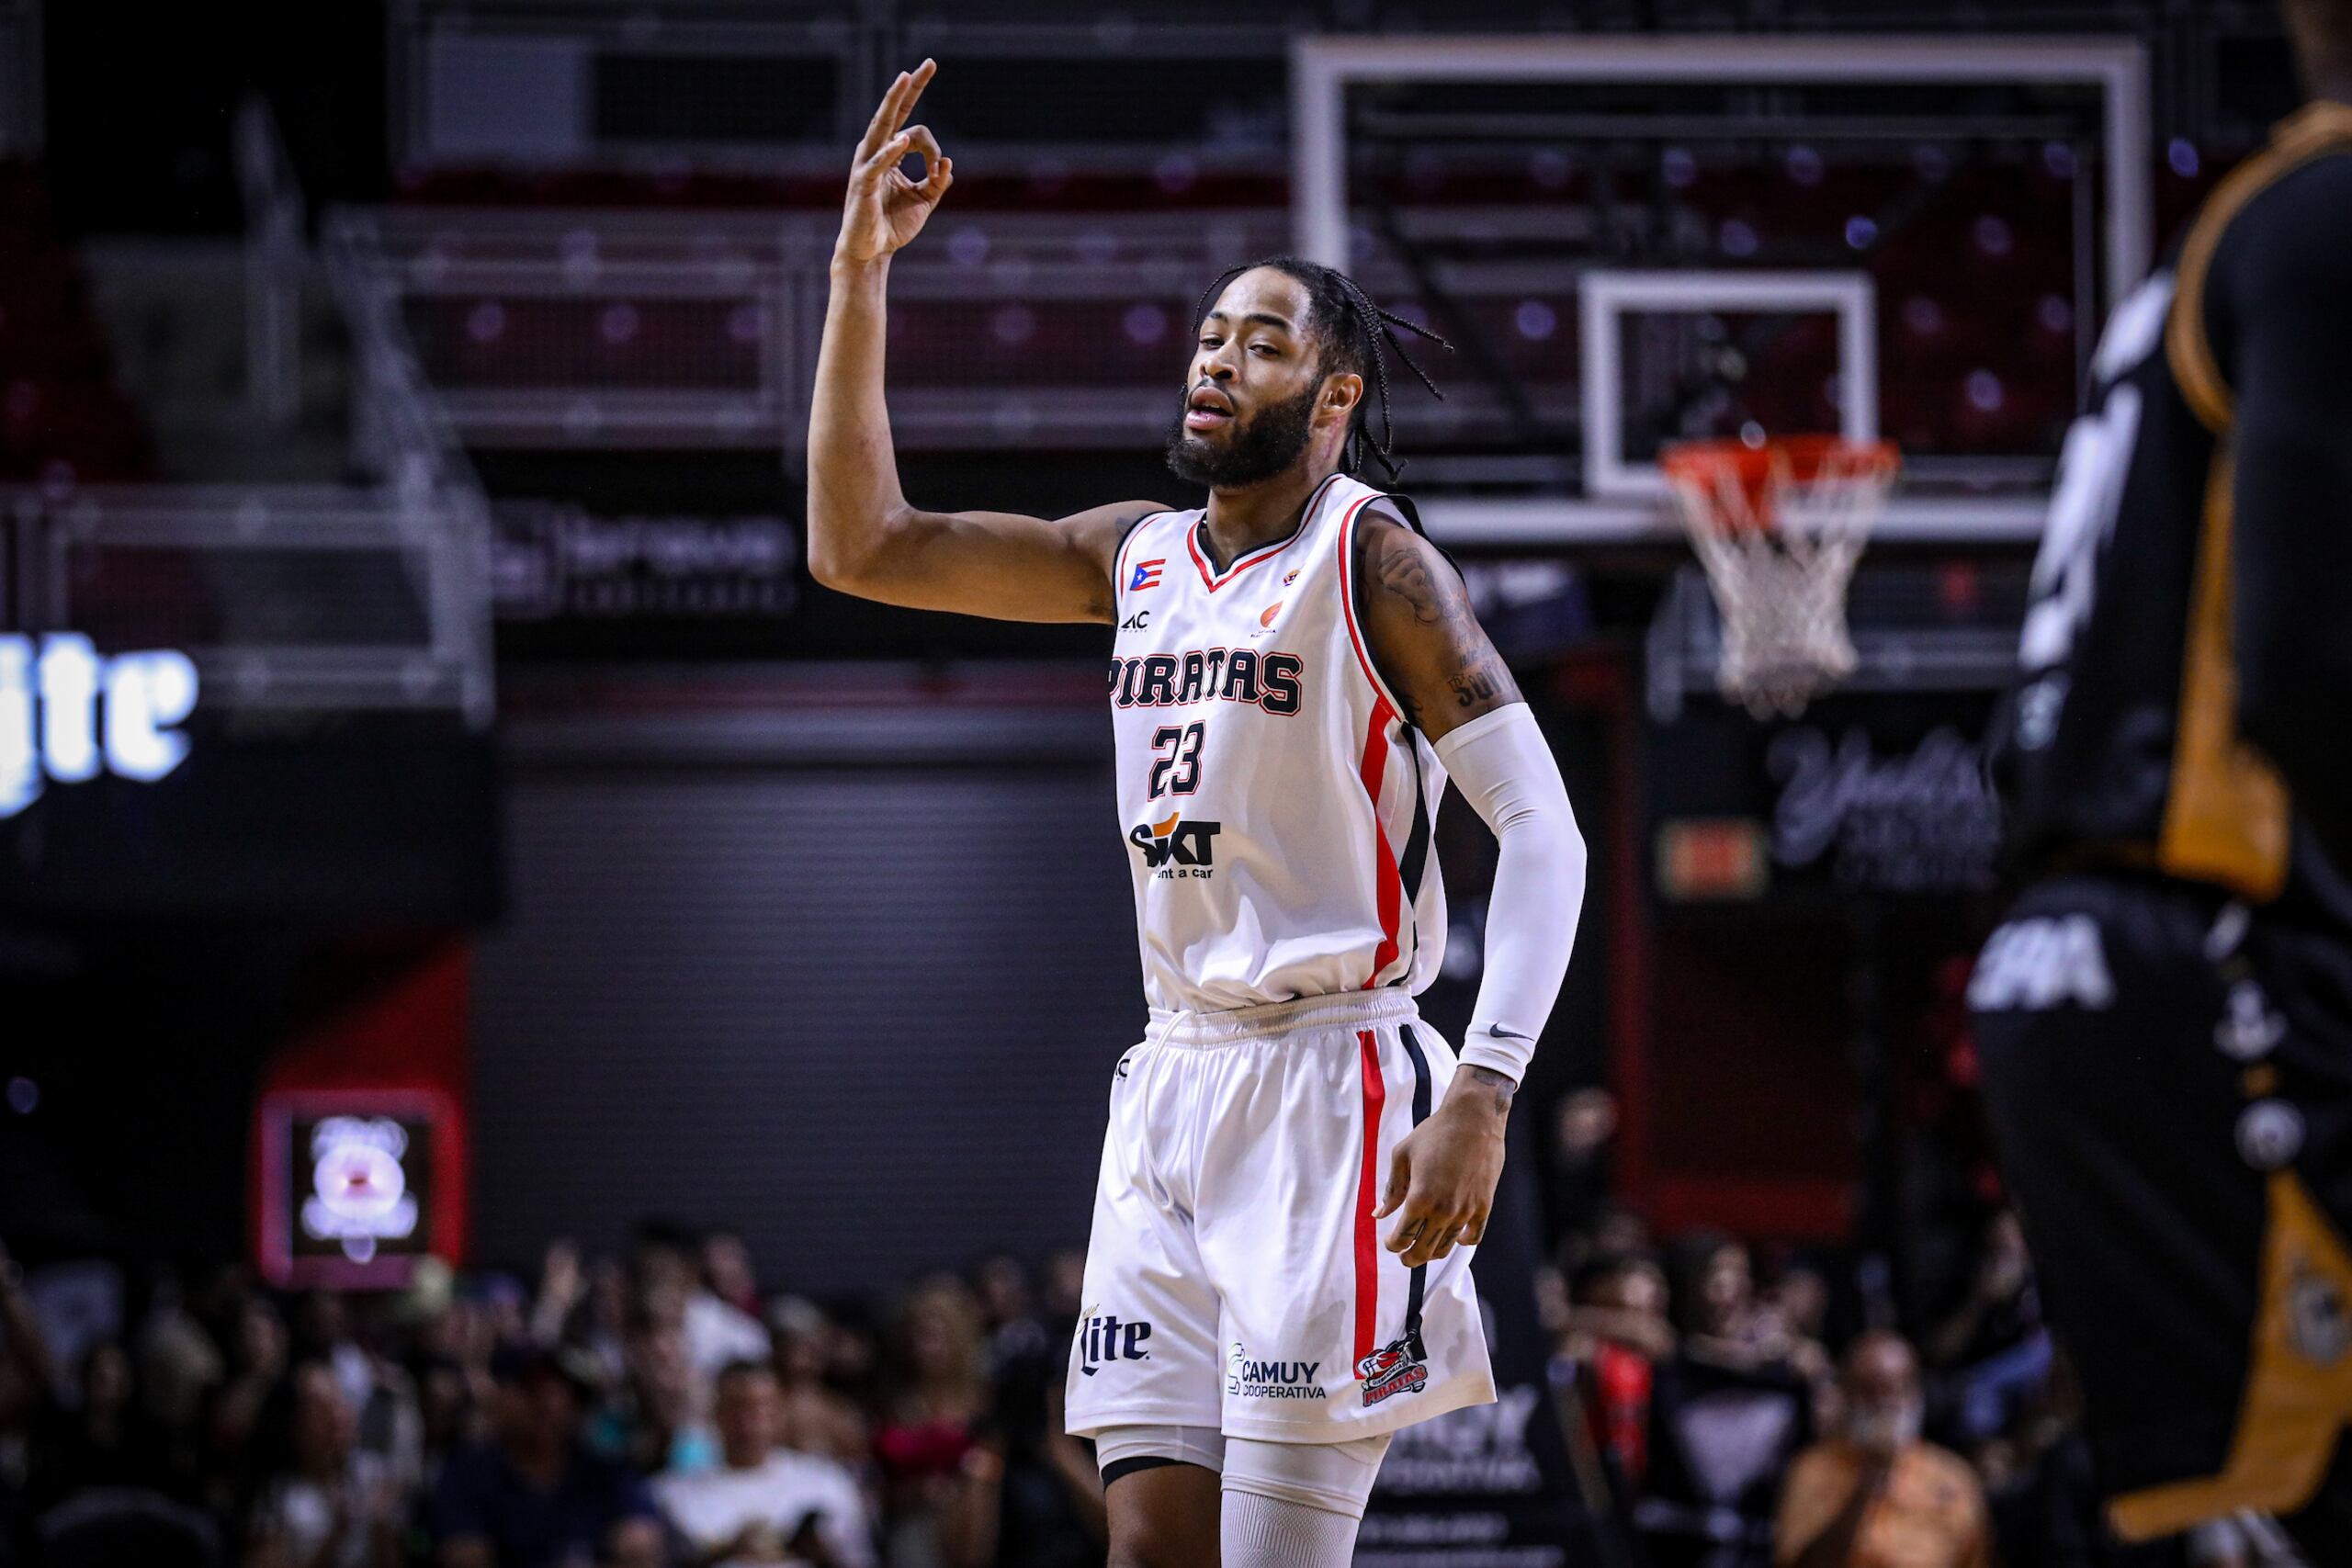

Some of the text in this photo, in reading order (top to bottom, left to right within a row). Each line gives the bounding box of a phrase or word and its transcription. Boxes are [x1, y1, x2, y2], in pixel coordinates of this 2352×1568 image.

[1148, 719, 1206, 803] 23
[1129, 811, 1221, 867] SIXT
[1178, 869, 1187, 878] a
[1192, 868, 1214, 879] car
[1080, 1315, 1152, 1376] Lite
[1242, 1360, 1320, 1384] CAMUY
[1242, 1385, 1327, 1399] COOPERATIVA
[1364, 1365, 1428, 1405] PIRATAS
